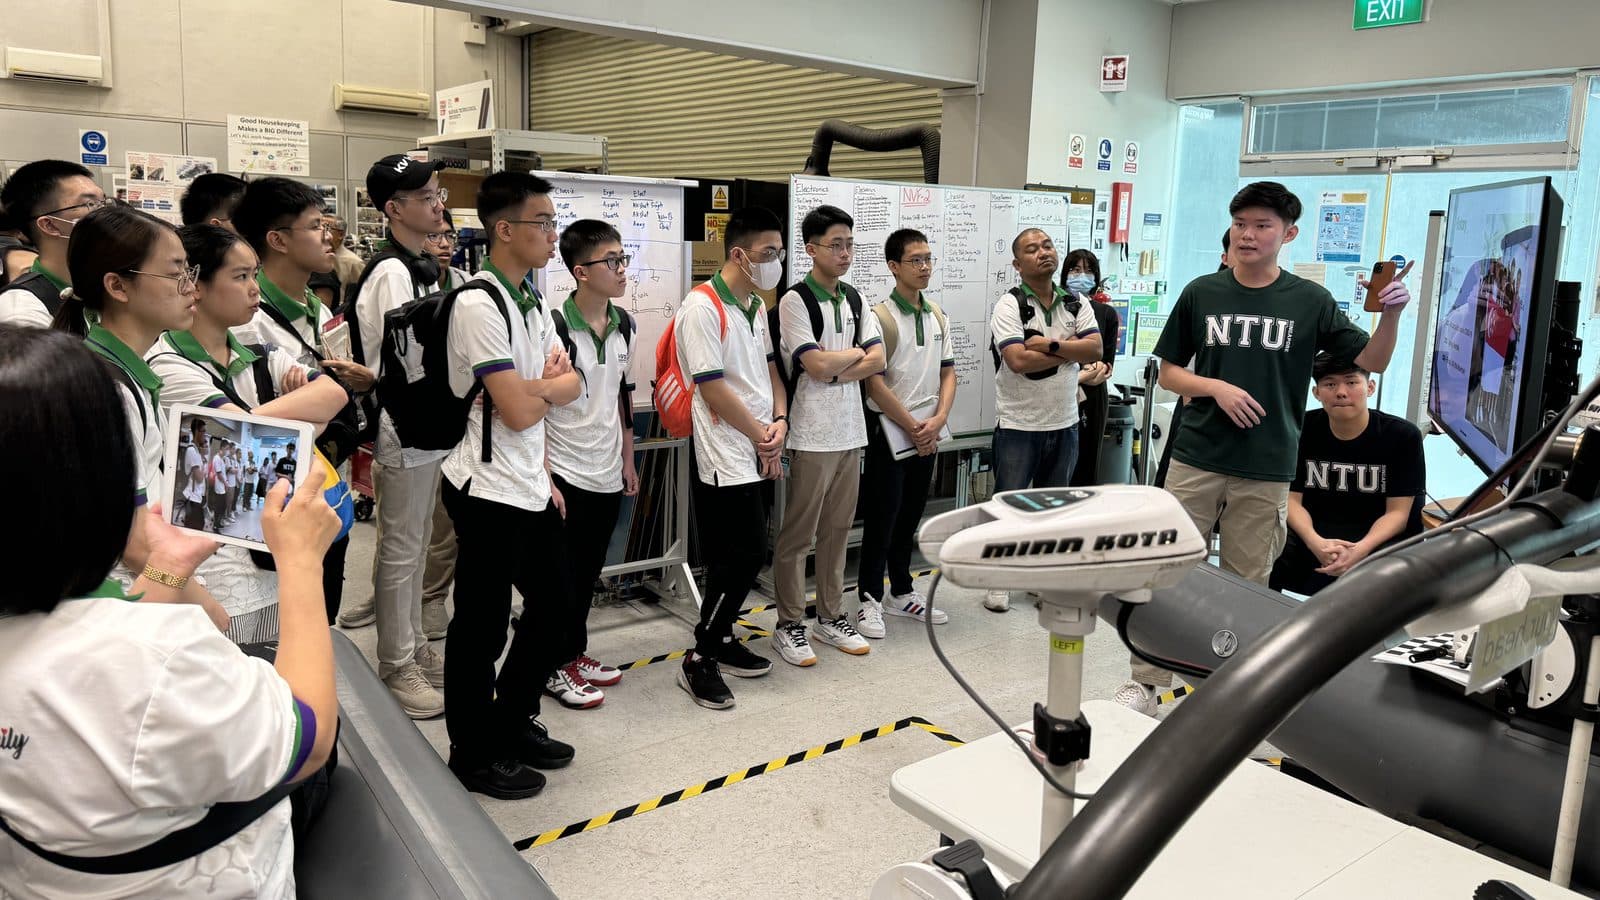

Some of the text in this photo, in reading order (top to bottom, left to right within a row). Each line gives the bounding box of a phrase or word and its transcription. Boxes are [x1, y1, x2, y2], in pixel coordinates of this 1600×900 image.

[1367, 0, 1404, 22] EXIT
[237, 125, 258, 133] Makes
[276, 128, 303, 136] Different
[258, 119, 301, 129] Housekeeping
[1205, 314, 1288, 351] NTU
[1304, 459, 1381, 494] NTU
[980, 528, 1178, 560] MINN KOTA
[1053, 640, 1077, 651] LEFT
